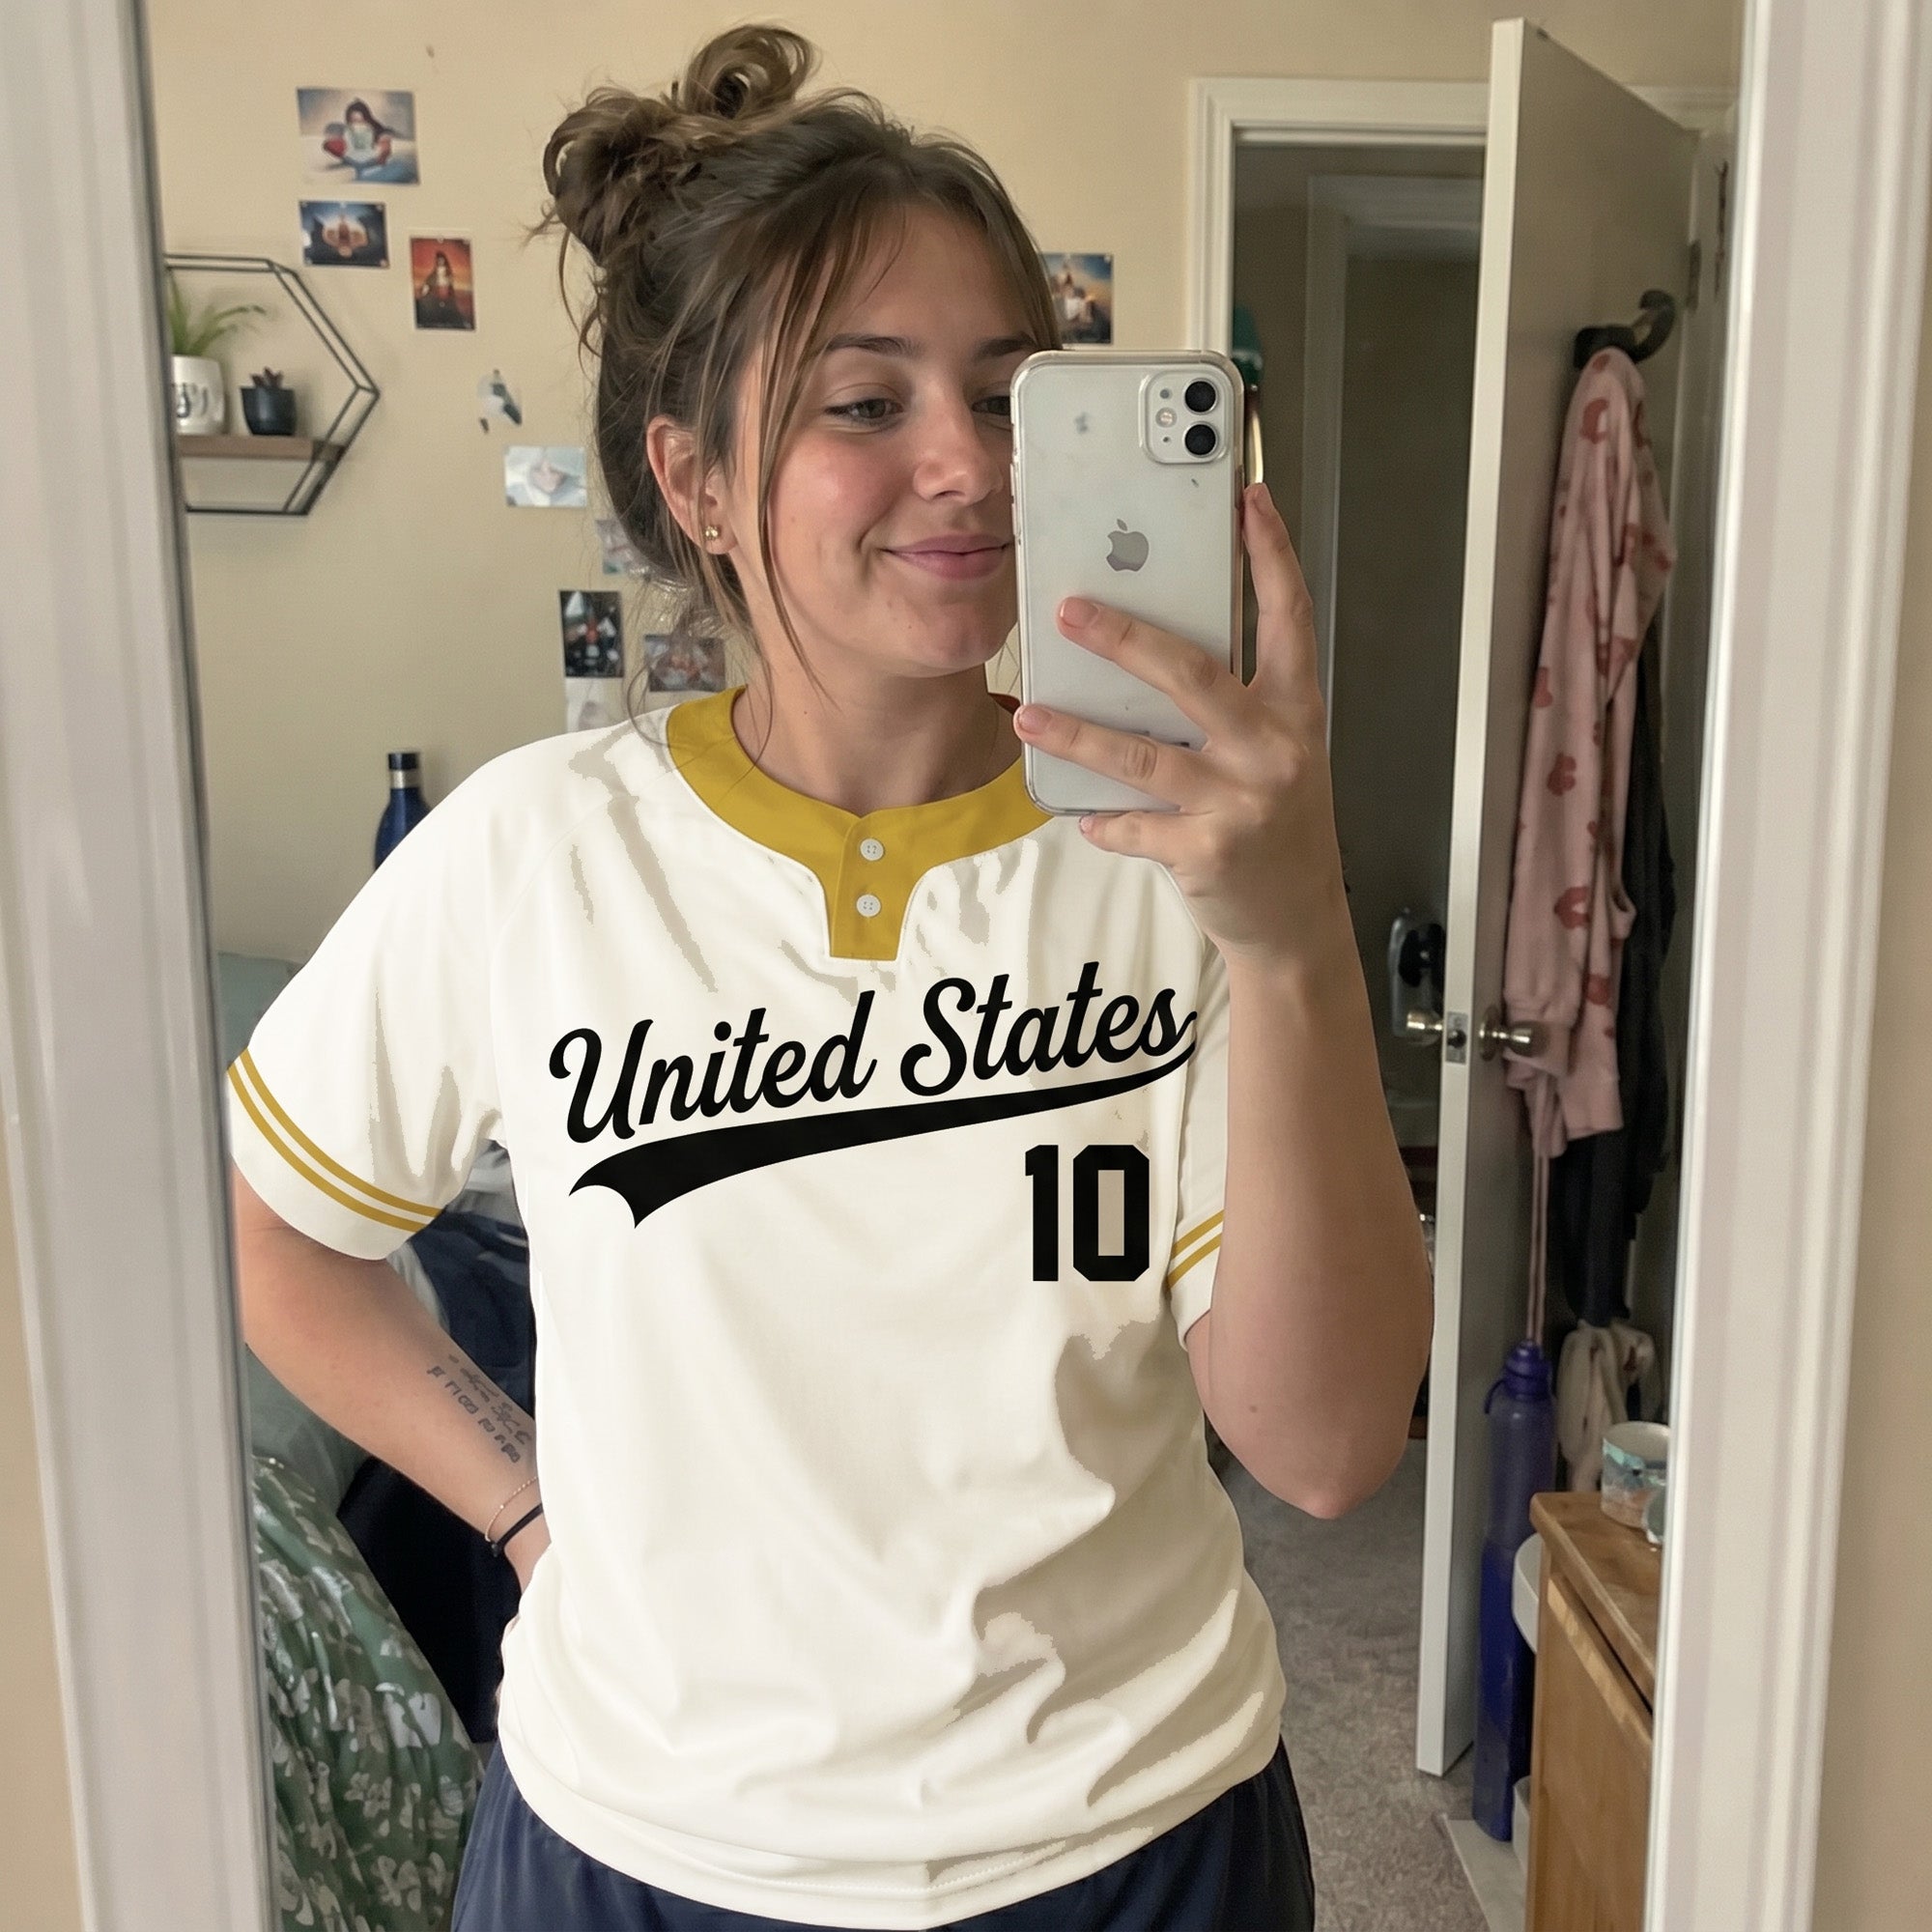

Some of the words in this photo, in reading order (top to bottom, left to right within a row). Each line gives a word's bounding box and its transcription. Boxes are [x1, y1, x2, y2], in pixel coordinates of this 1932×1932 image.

[550, 990, 877, 1143] United
[900, 961, 1198, 1096] States
[1025, 1145, 1150, 1281] 10
